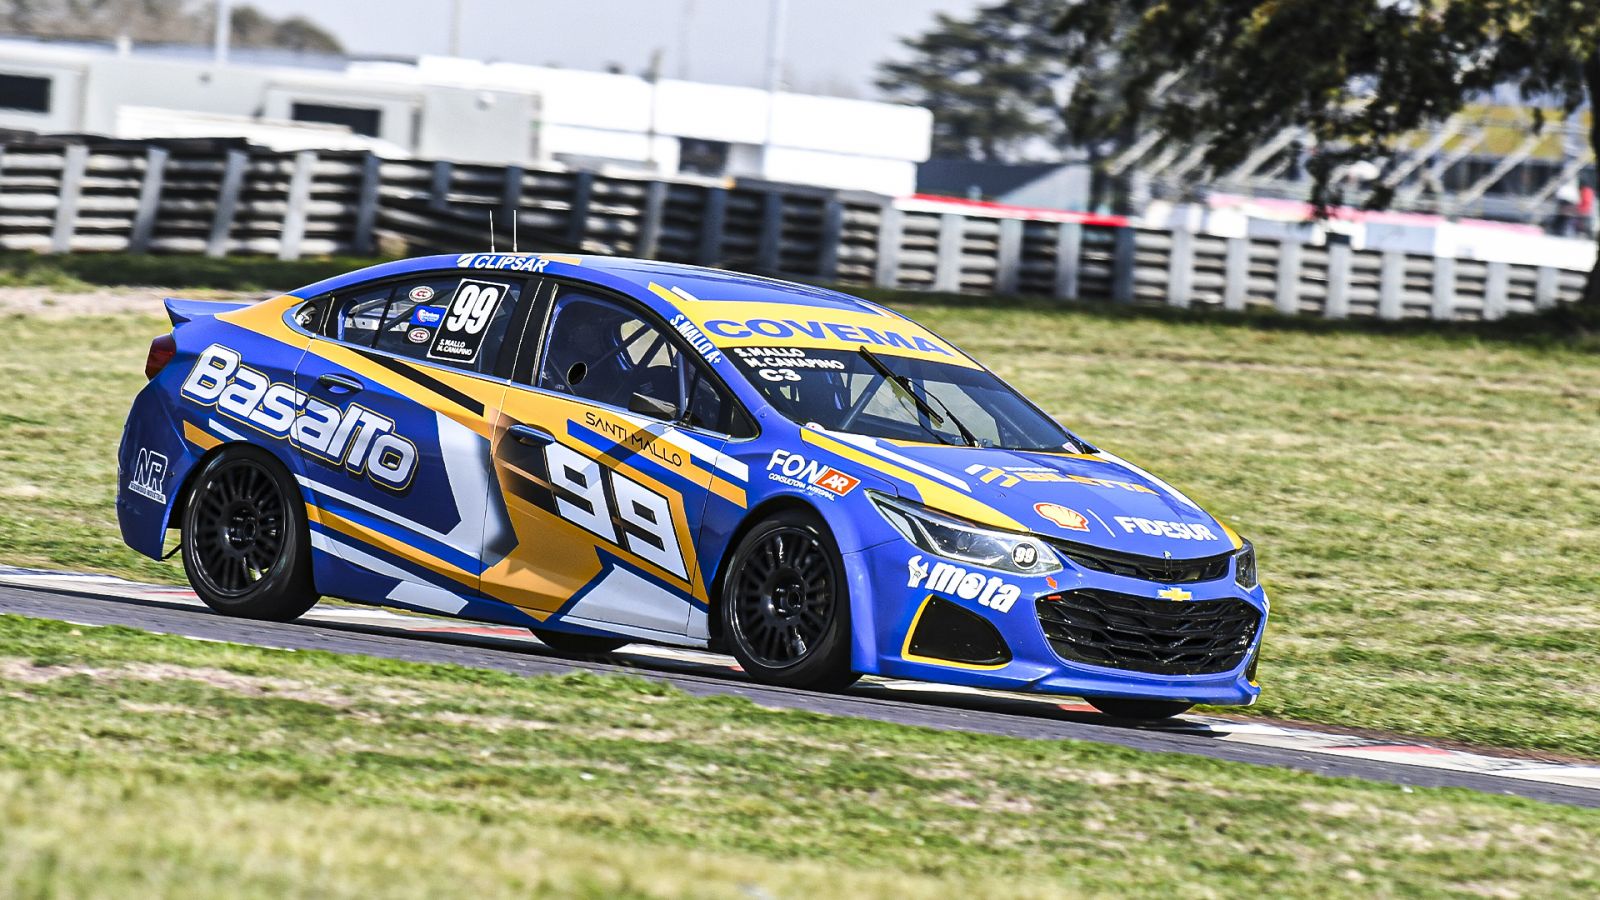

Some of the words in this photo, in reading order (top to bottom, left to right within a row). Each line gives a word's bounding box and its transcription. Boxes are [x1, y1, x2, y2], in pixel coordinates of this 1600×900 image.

[475, 255, 549, 273] CLIPSAR
[447, 284, 499, 335] 99
[704, 319, 955, 357] COVEMA
[758, 369, 802, 382] C3
[585, 411, 628, 442] SANTI
[631, 433, 682, 467] MALLO
[133, 447, 168, 495] NR
[544, 441, 692, 581] 99
[1114, 516, 1218, 541] FIDESUR
[1014, 547, 1036, 564] 99
[924, 562, 1022, 613] mota
